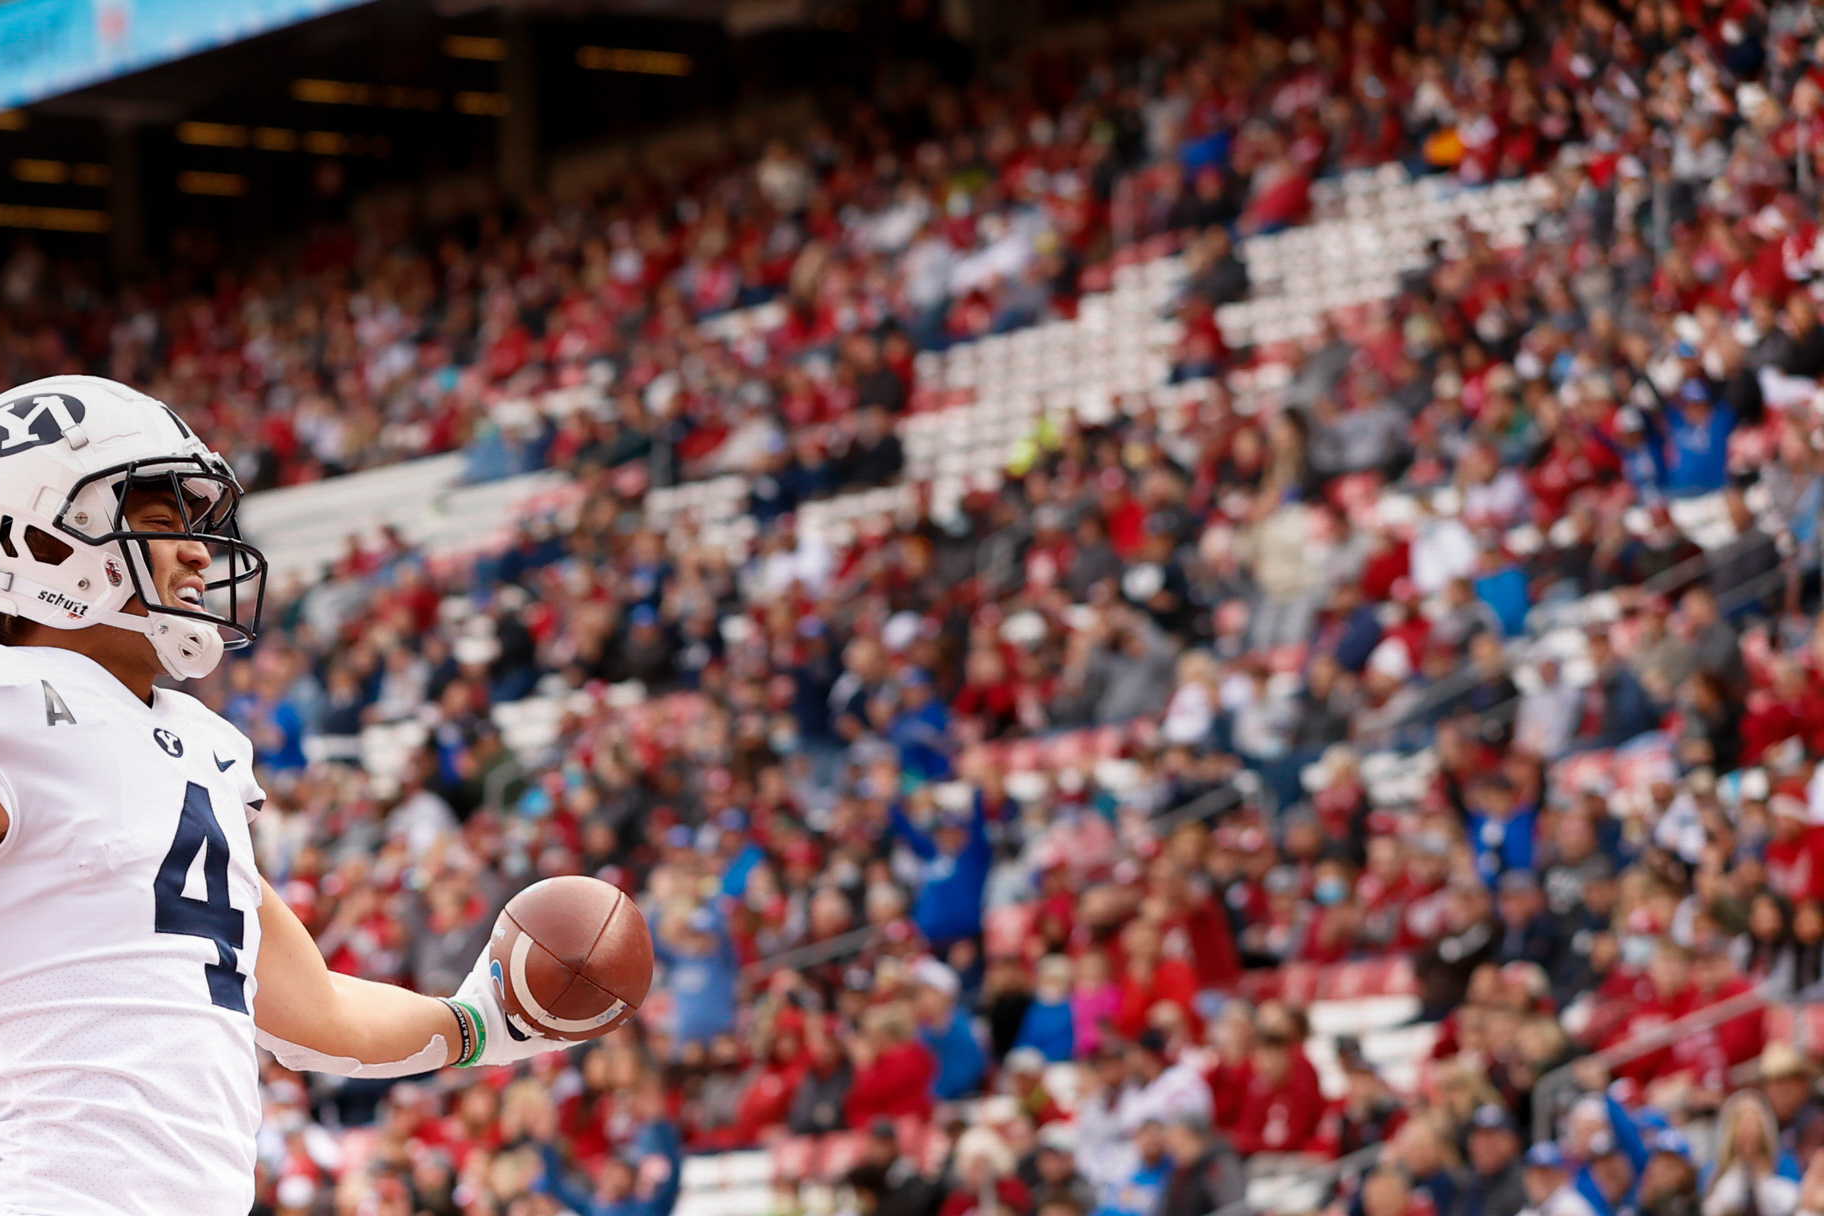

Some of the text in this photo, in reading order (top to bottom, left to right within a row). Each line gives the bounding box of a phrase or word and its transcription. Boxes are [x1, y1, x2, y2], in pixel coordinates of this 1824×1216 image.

[37, 590, 89, 616] schutt
[41, 679, 78, 726] A
[153, 780, 250, 1016] 4
